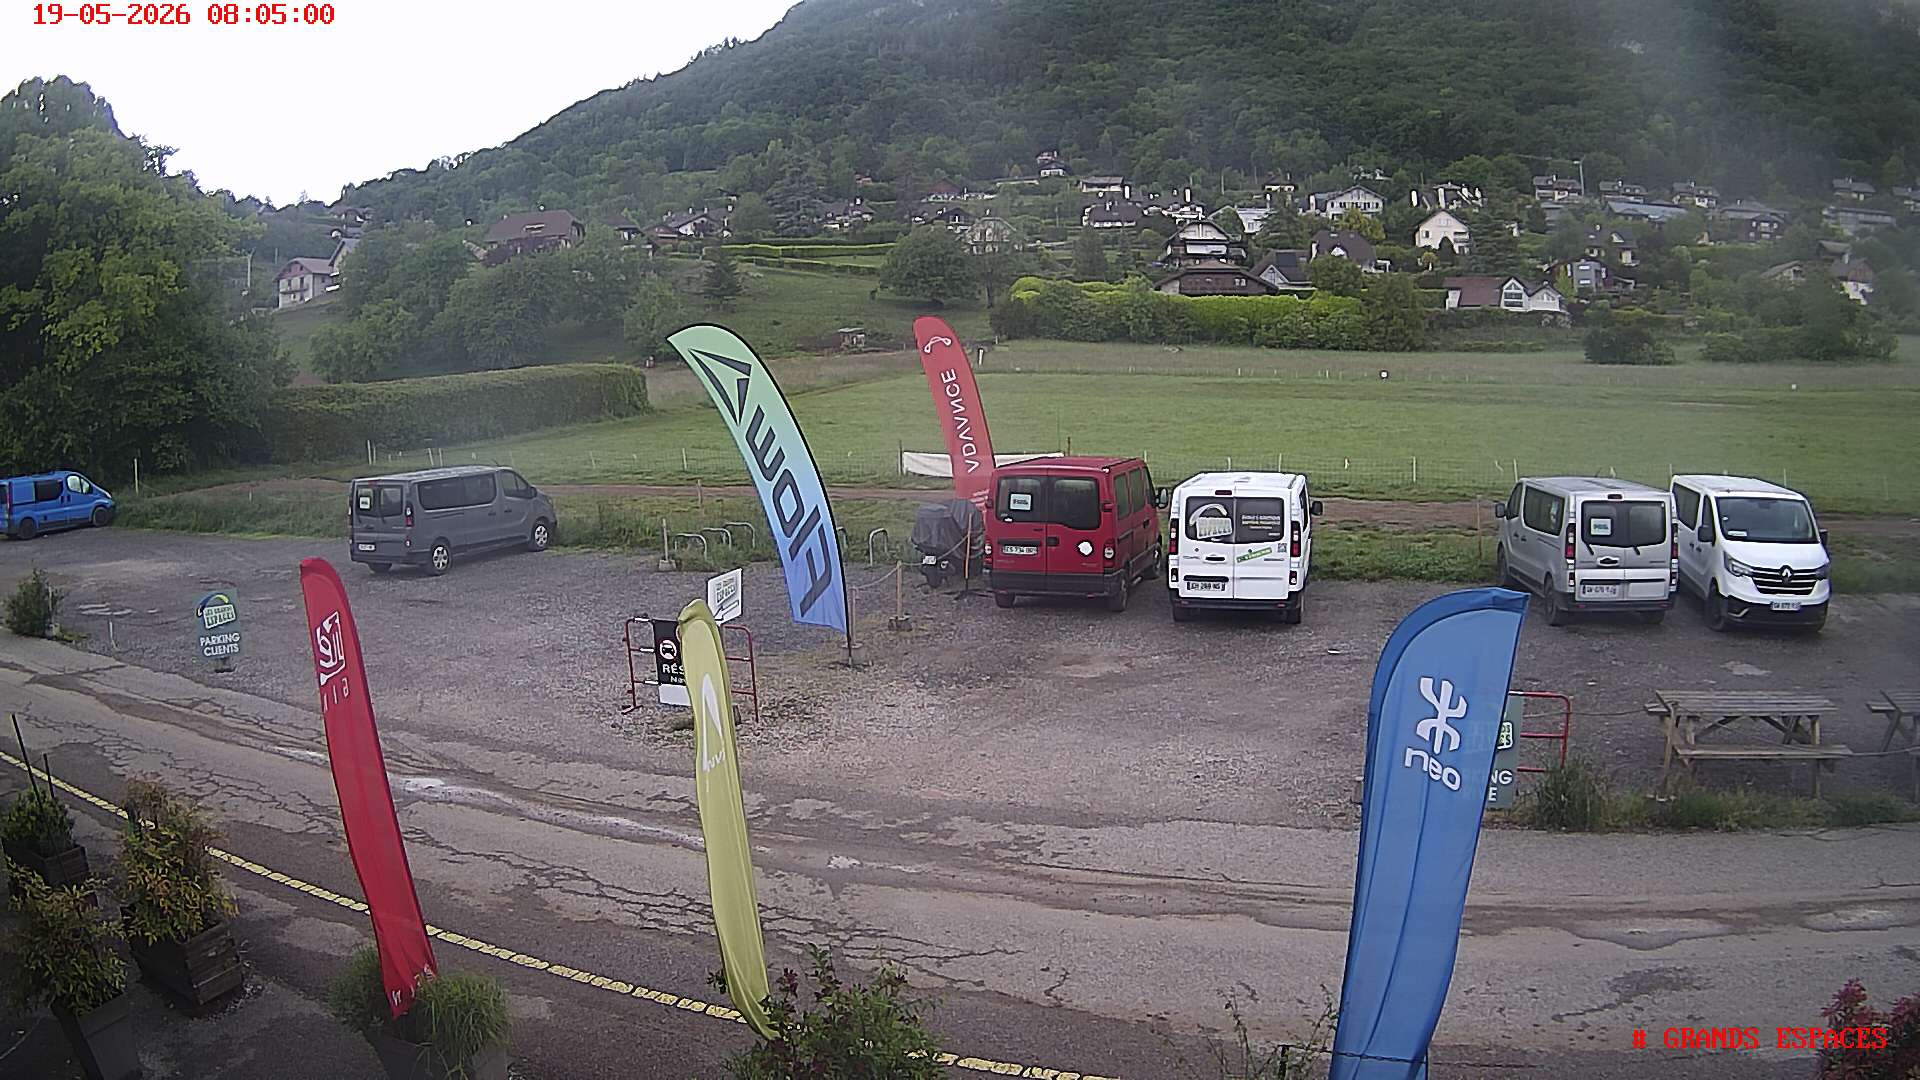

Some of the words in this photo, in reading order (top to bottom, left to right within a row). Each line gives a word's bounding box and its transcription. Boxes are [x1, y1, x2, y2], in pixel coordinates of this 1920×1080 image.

[199, 632, 240, 647] PARKING
[203, 643, 239, 656] CLIENTS
[1404, 747, 1462, 791] neo
